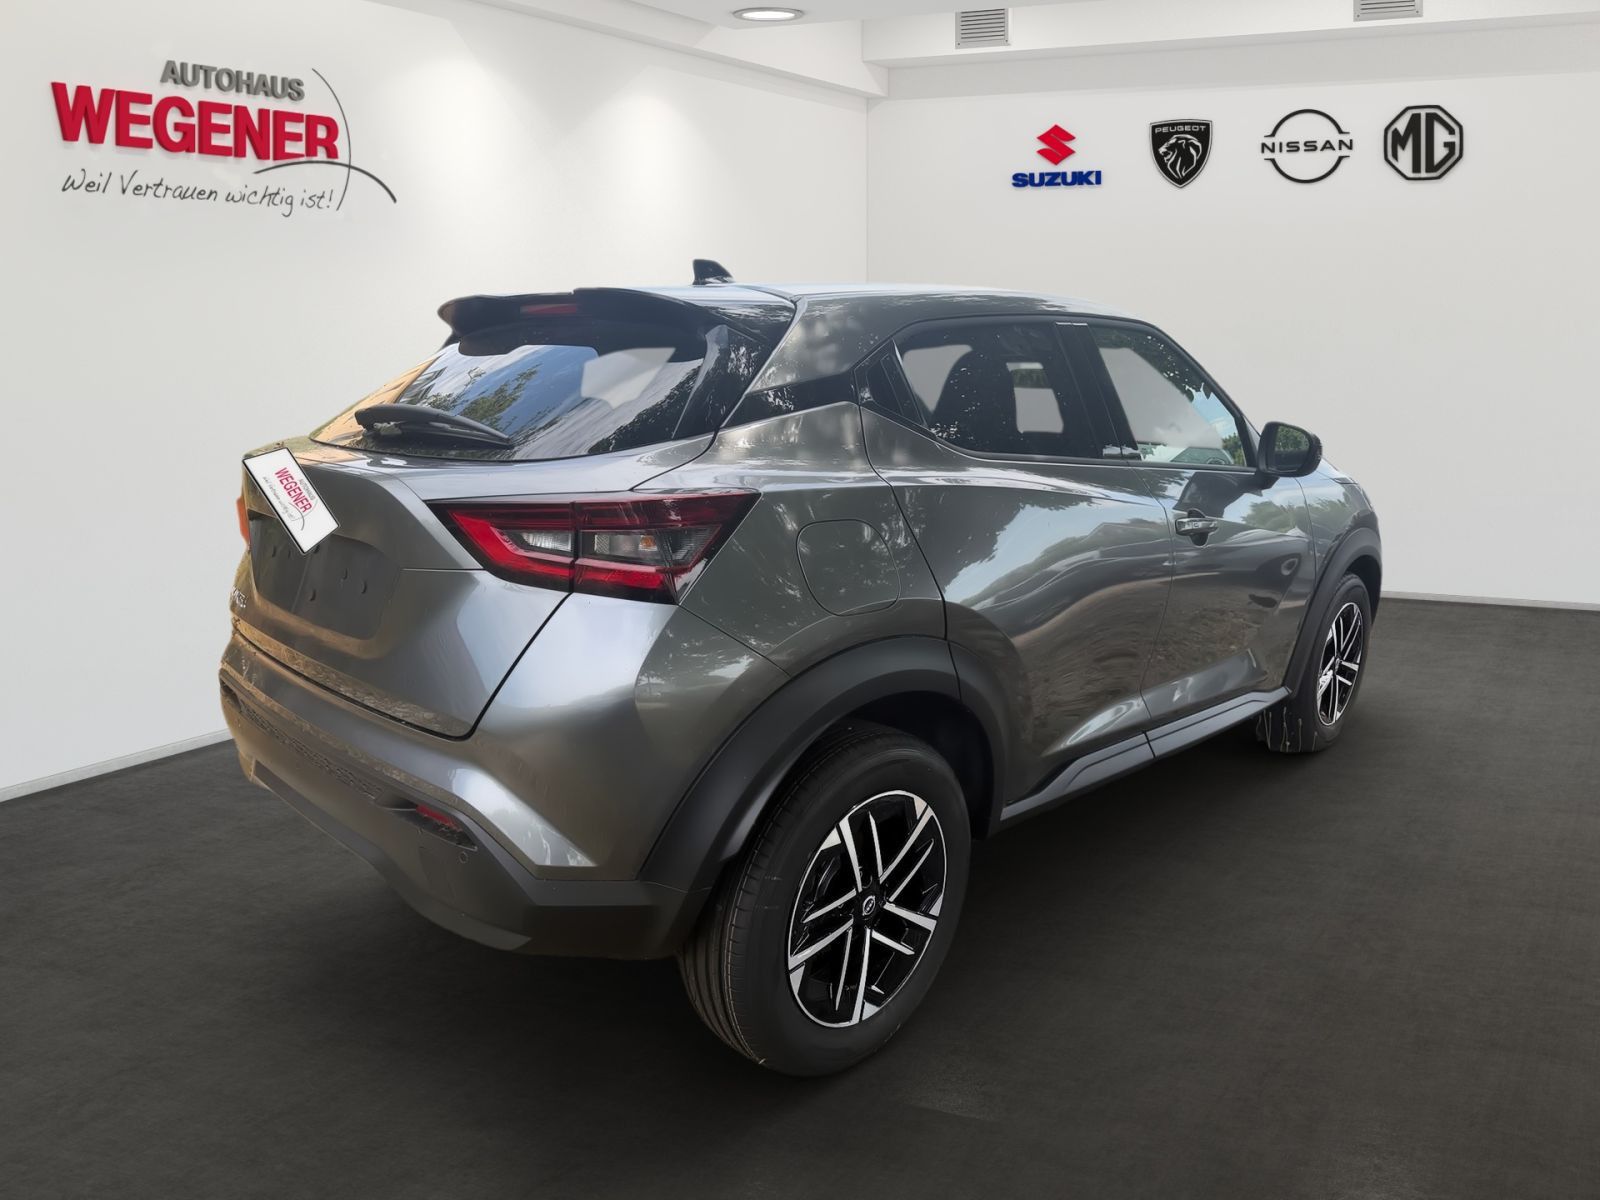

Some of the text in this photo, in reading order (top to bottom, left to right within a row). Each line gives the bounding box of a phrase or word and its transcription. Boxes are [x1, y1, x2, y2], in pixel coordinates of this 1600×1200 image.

[160, 60, 305, 101] AUTOHAUS
[51, 81, 339, 160] WEGENER
[1154, 125, 1207, 134] PEUGEOT
[1261, 138, 1354, 154] NISSAN
[1392, 111, 1456, 175] MG
[61, 168, 334, 217] Weil Vertrauen wichtig ist!
[1011, 170, 1102, 188] SUZUKI
[274, 466, 313, 513] WEGENER
